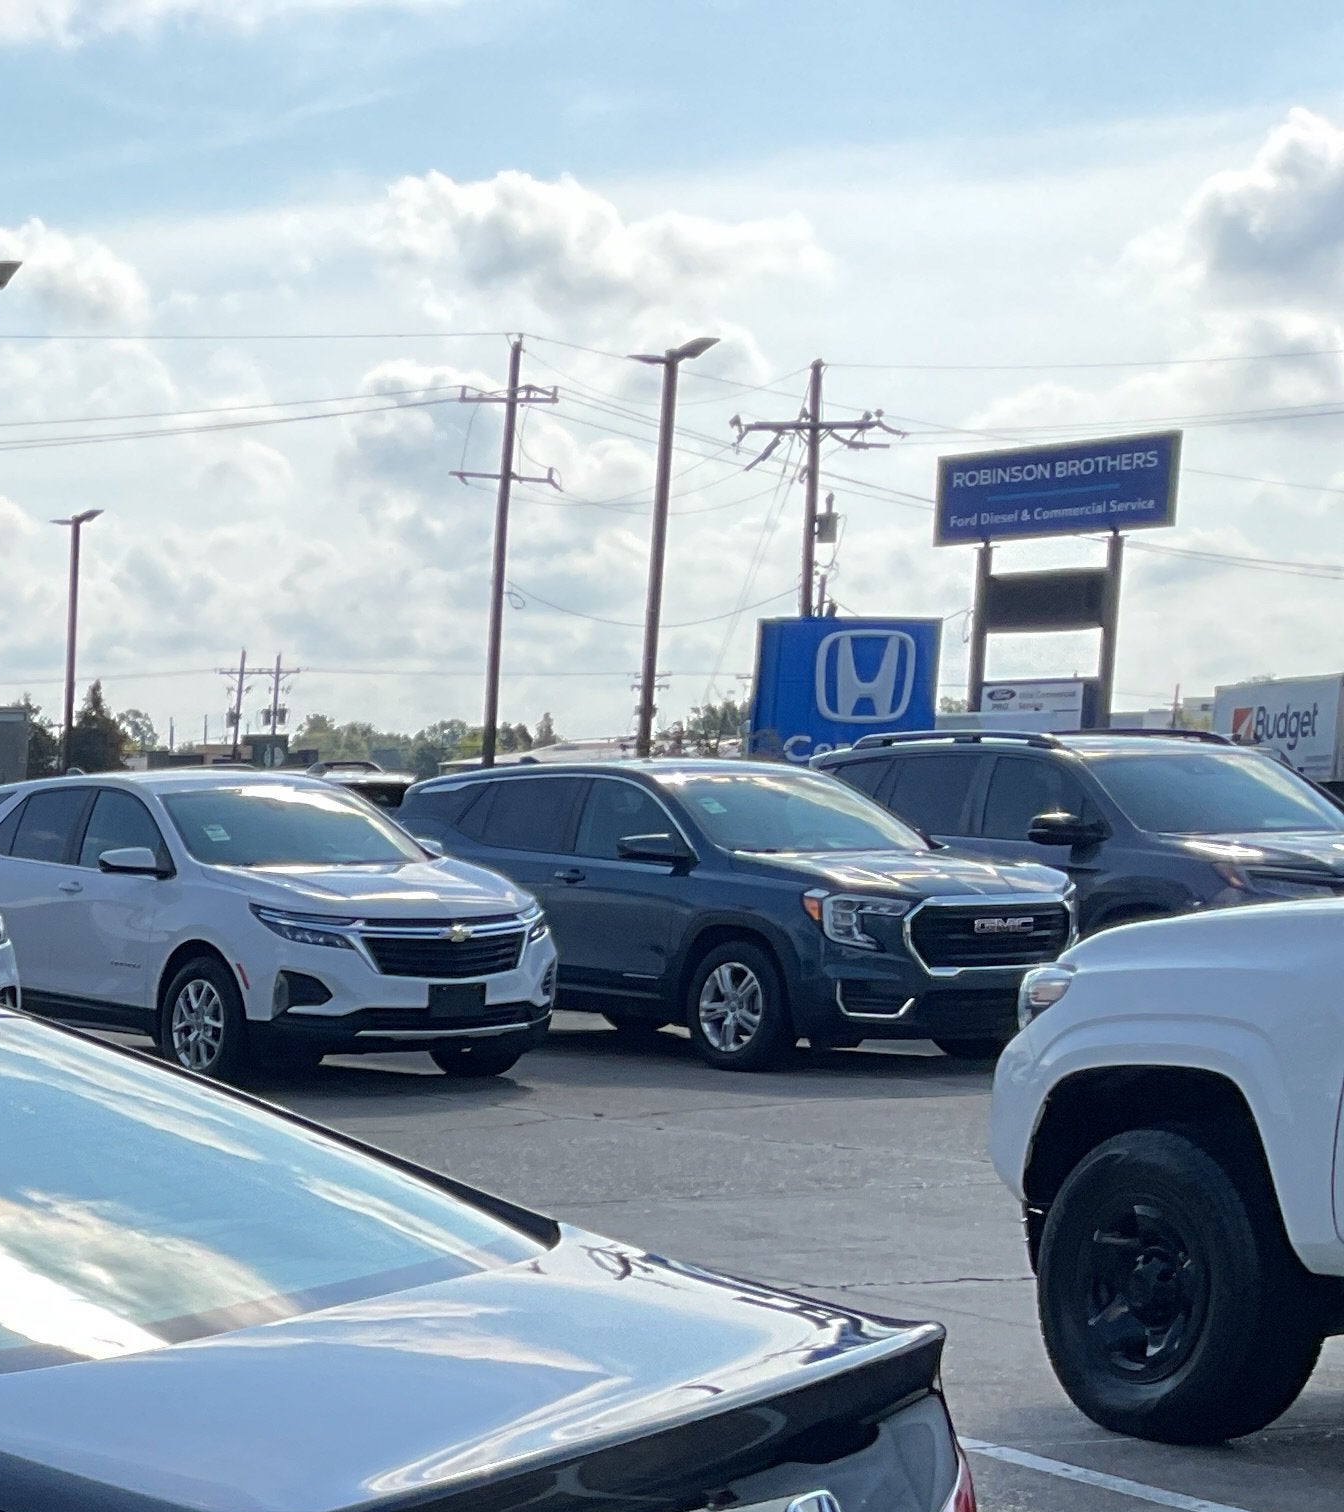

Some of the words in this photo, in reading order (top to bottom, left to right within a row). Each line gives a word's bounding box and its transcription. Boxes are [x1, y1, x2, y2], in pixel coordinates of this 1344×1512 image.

[952, 462, 1051, 489] ROBINSON
[1054, 450, 1159, 479] BROTHERS
[950, 512, 977, 528] Ford
[980, 508, 1018, 526] Diesel
[1020, 508, 1031, 521] &
[1033, 501, 1106, 521] Commercial
[1109, 497, 1156, 514] Service
[1255, 702, 1318, 751] Budget
[974, 917, 1034, 934] GMC
